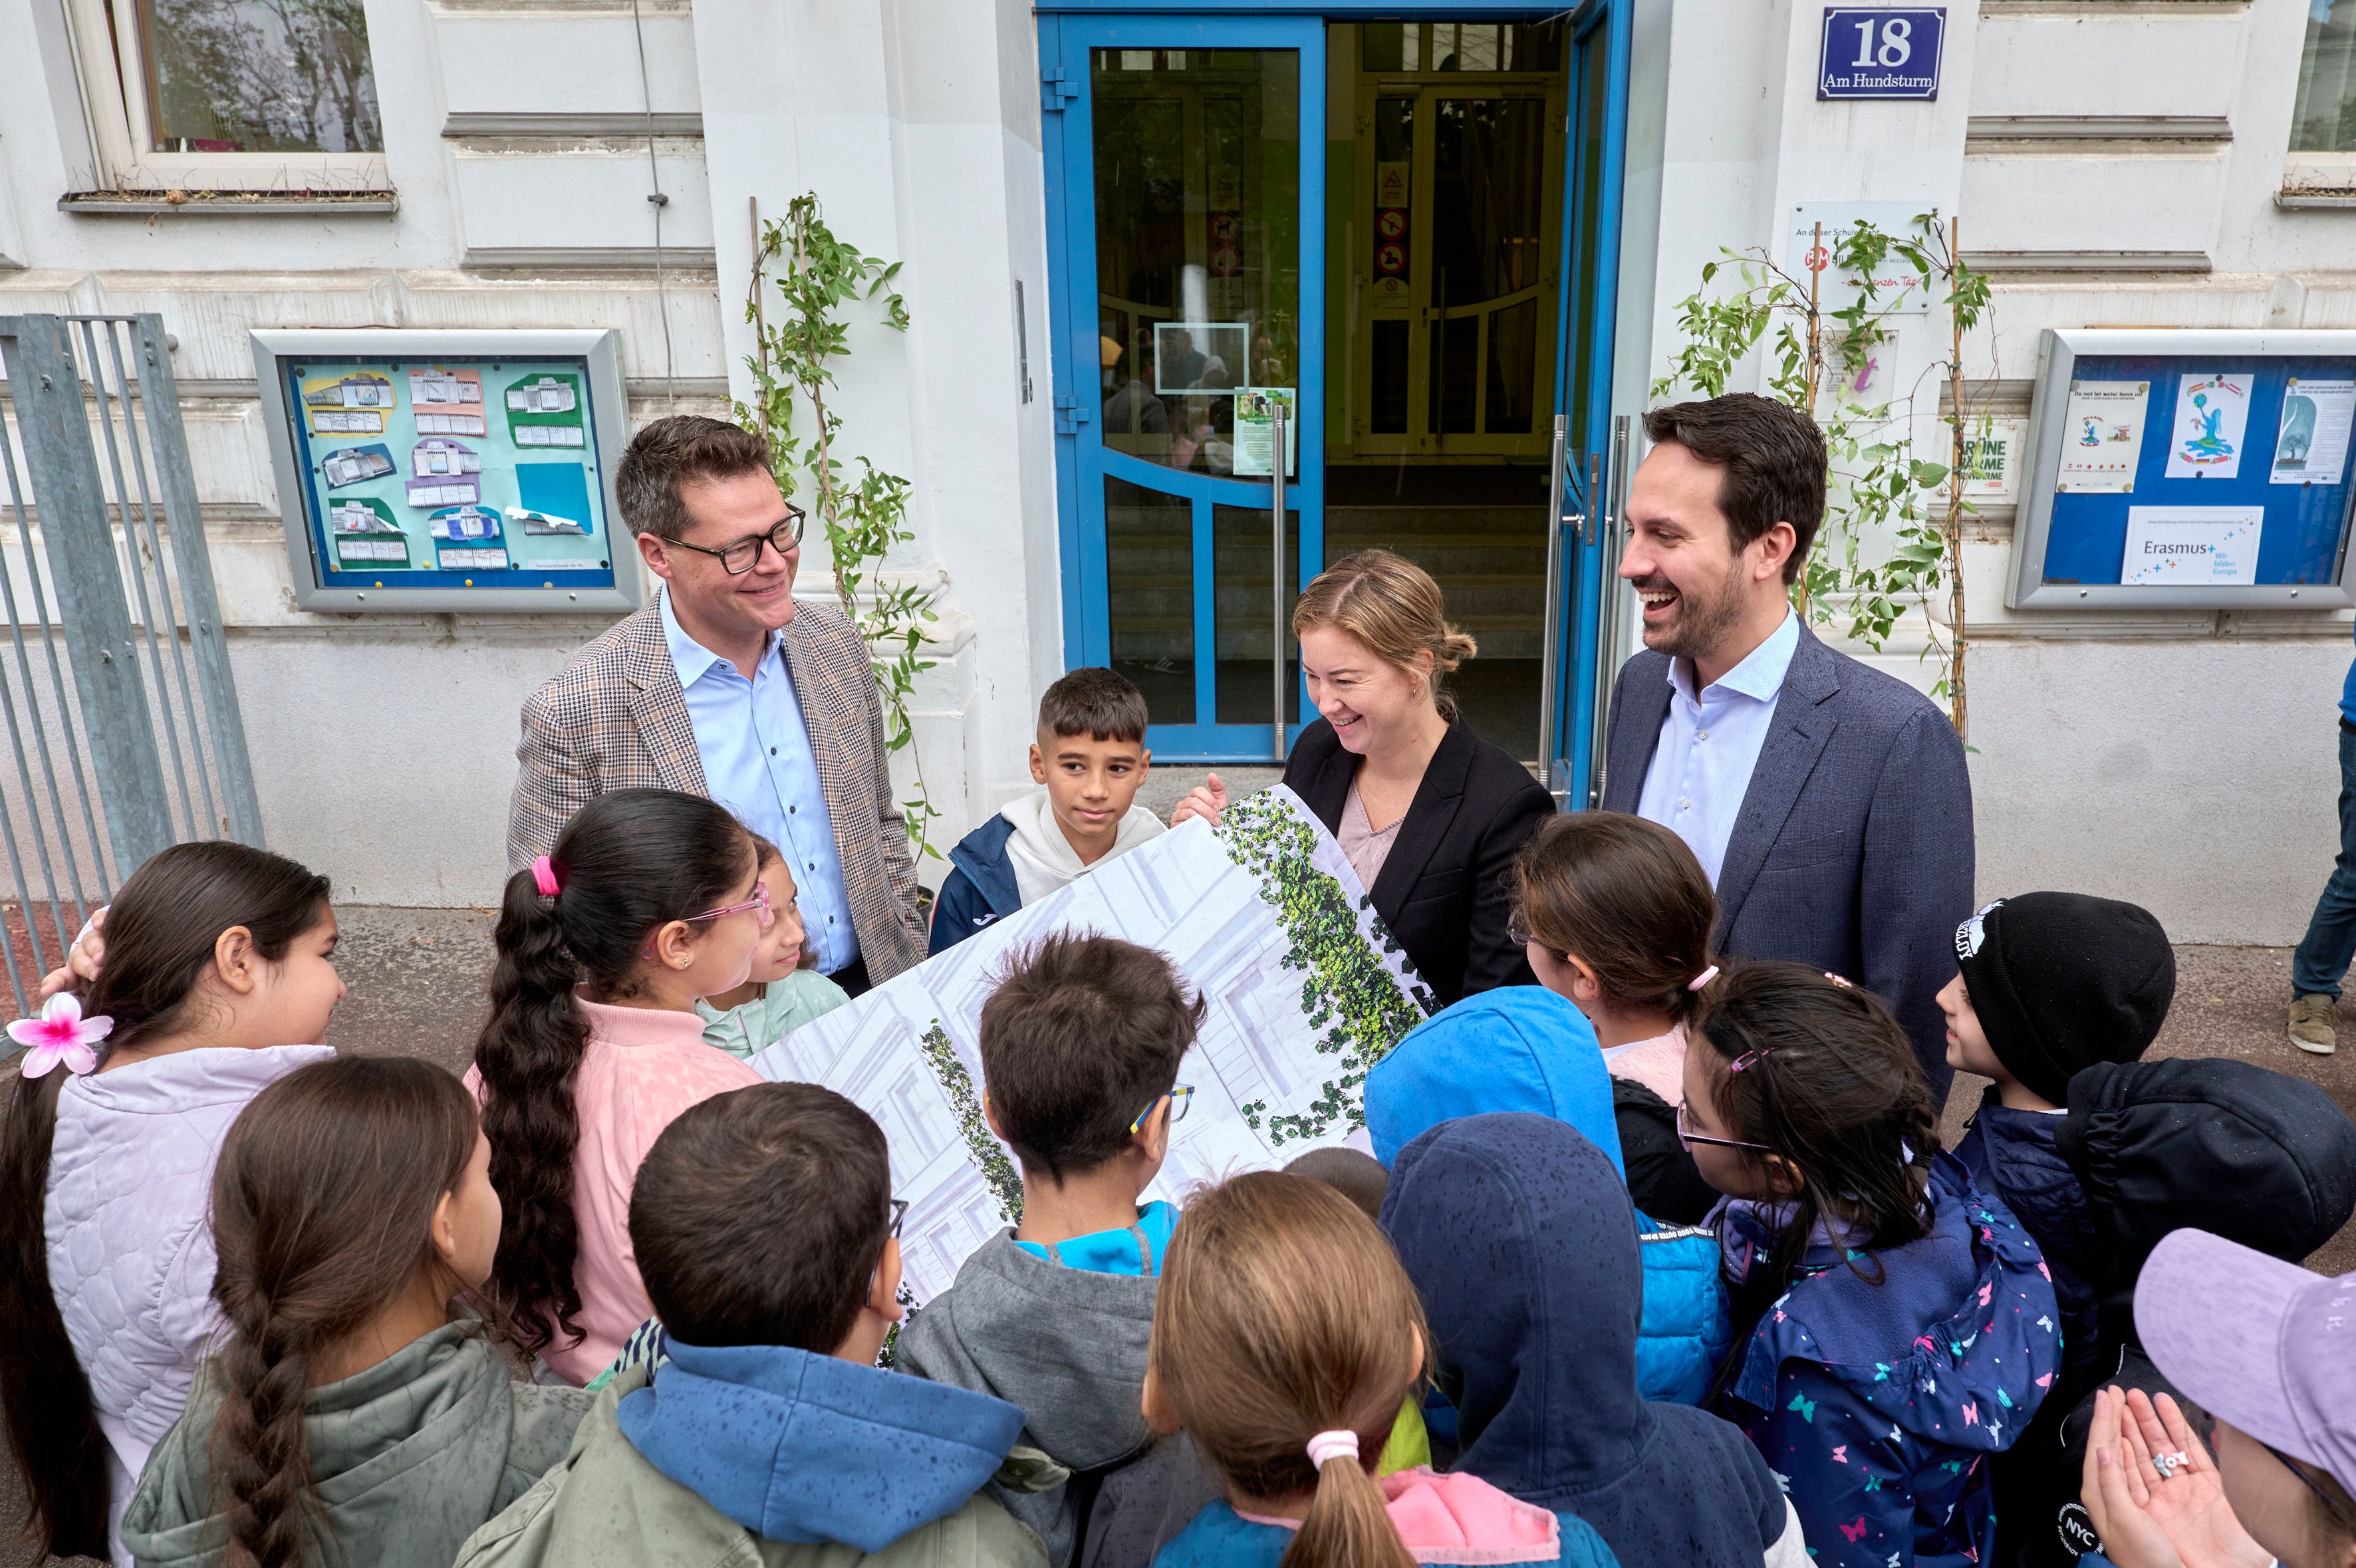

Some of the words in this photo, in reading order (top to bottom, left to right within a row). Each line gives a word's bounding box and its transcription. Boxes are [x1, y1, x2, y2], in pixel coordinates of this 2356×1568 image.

[1851, 19, 1912, 67] 18
[1824, 74, 1850, 88] Am
[1853, 73, 1932, 88] Hundsturm
[1869, 277, 1899, 286] anzen
[1900, 276, 1916, 291] Tag
[1964, 437, 2007, 456] RÜNE
[2144, 541, 2216, 554] Erasmus+
[2065, 1517, 2095, 1547] NYC
